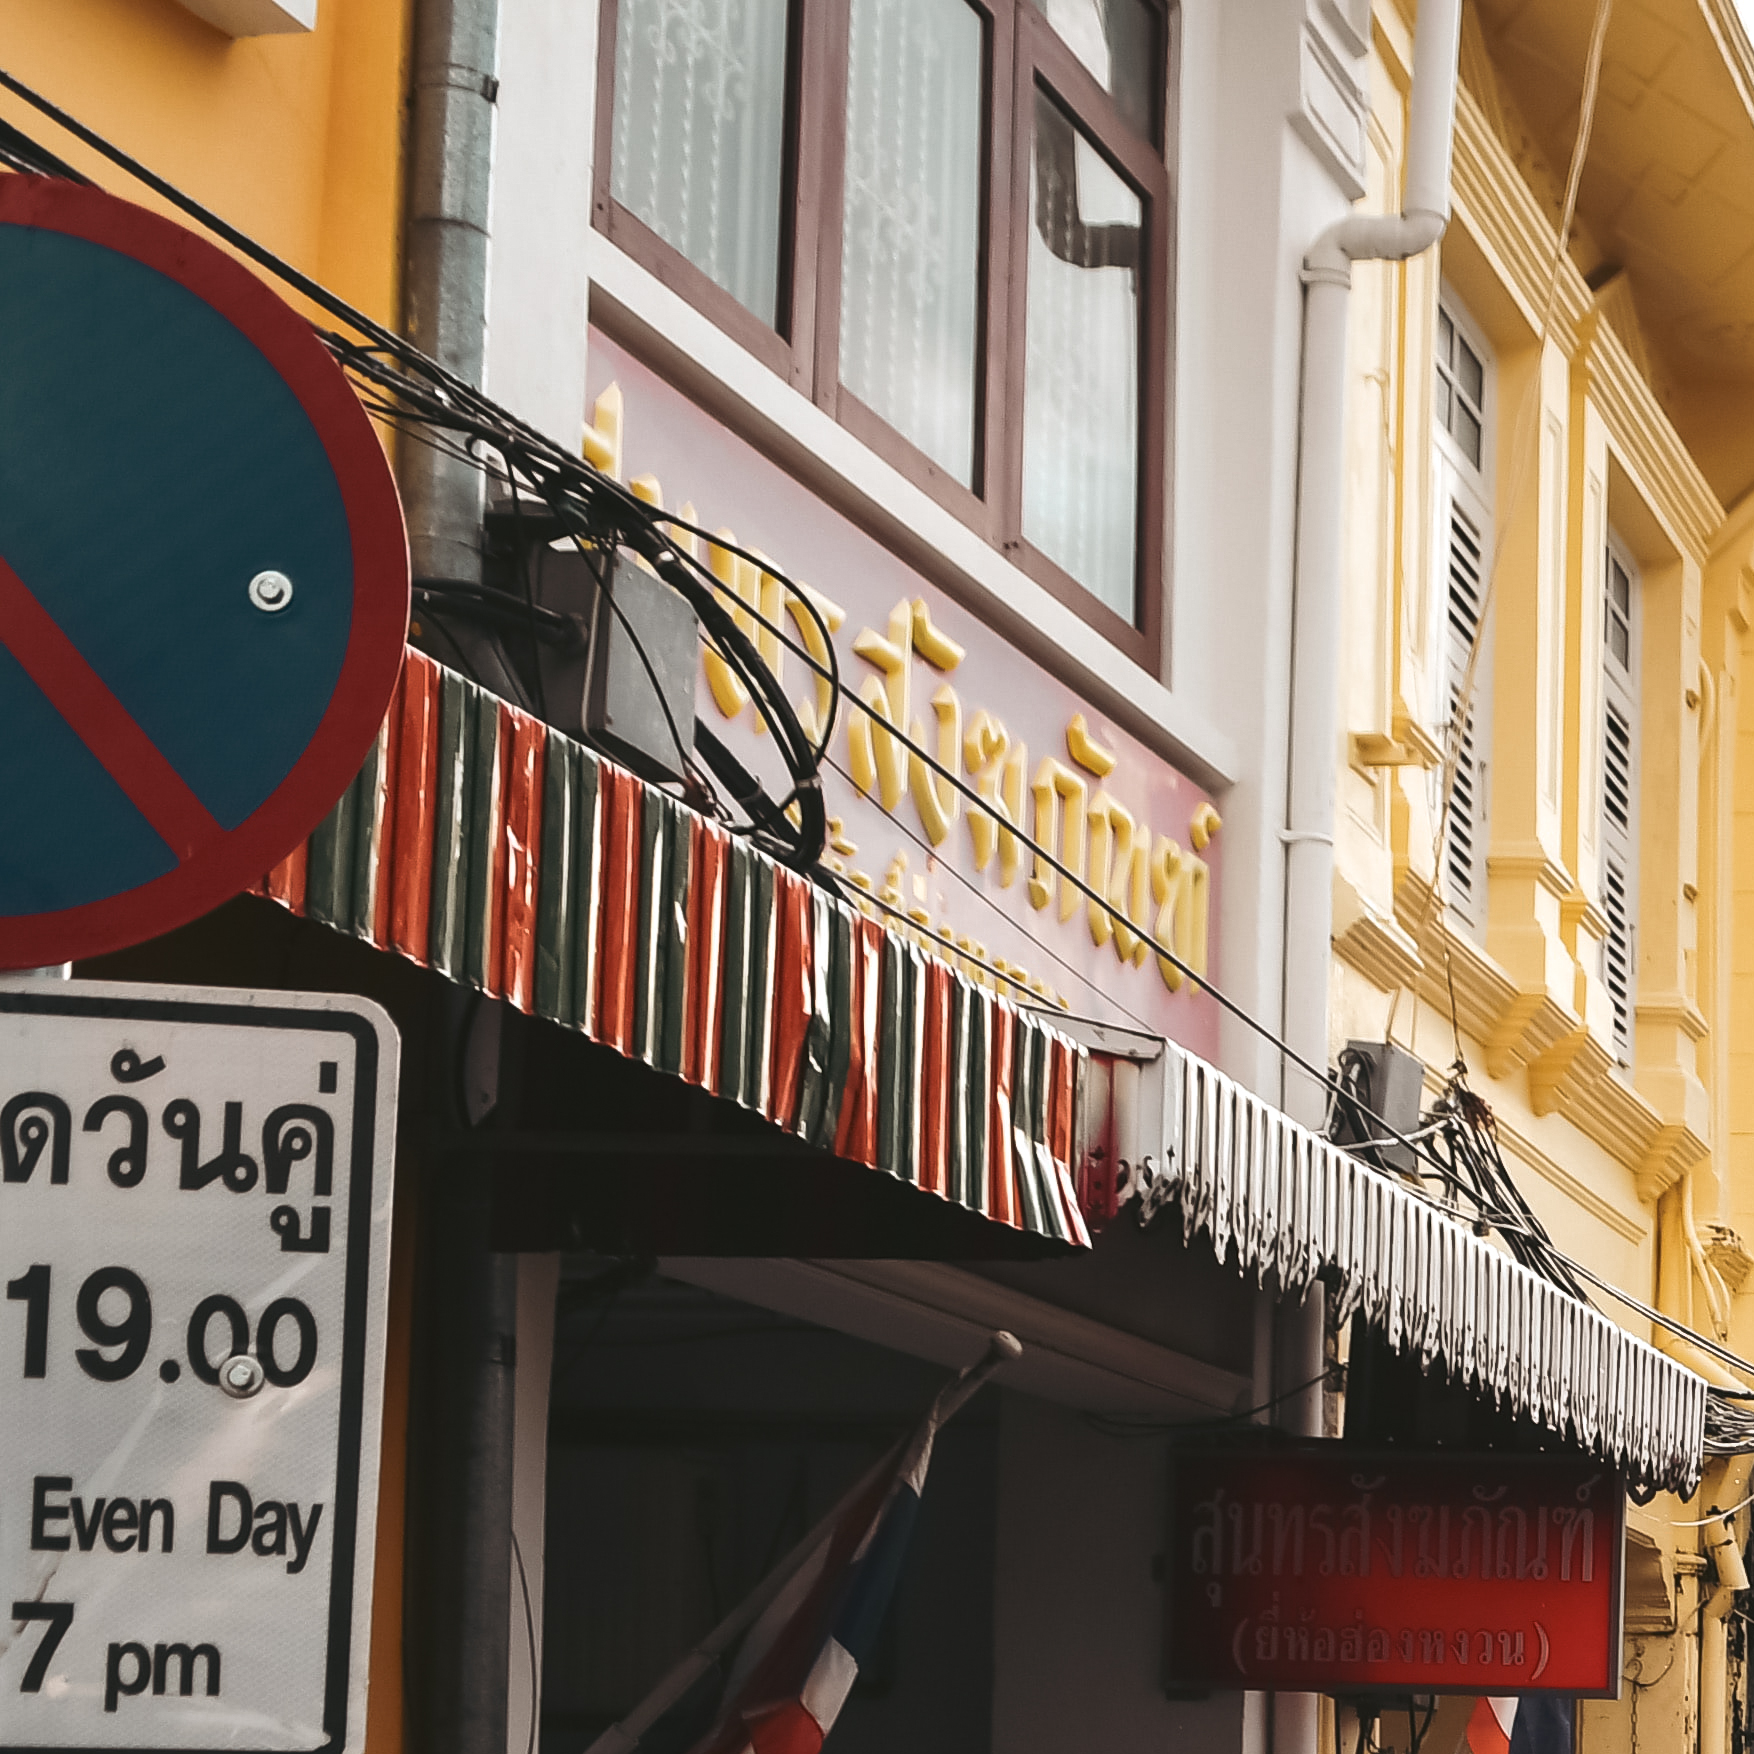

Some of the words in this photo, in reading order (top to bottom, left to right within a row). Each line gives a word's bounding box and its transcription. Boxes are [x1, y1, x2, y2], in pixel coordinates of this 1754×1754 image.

[6, 1263, 319, 1388] 19.00
[30, 1475, 175, 1553] Even
[206, 1480, 324, 1575] Day
[10, 1601, 75, 1694] 7
[104, 1639, 221, 1713] pm
